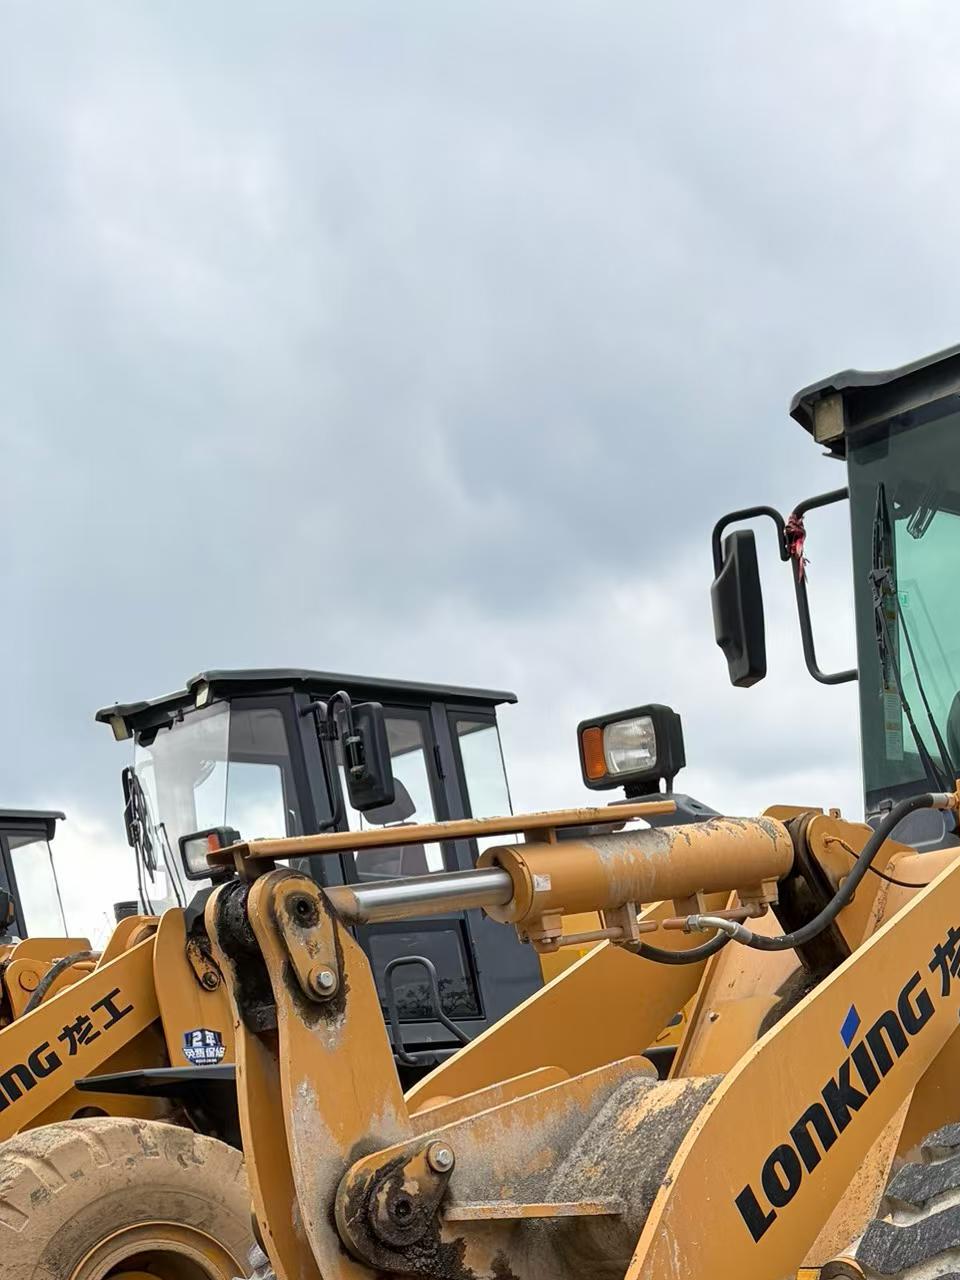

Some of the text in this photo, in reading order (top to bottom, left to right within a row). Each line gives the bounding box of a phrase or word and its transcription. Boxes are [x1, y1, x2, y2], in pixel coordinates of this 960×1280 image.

[0, 987, 134, 1112] NG 龙工
[734, 971, 935, 1243] LONKING
